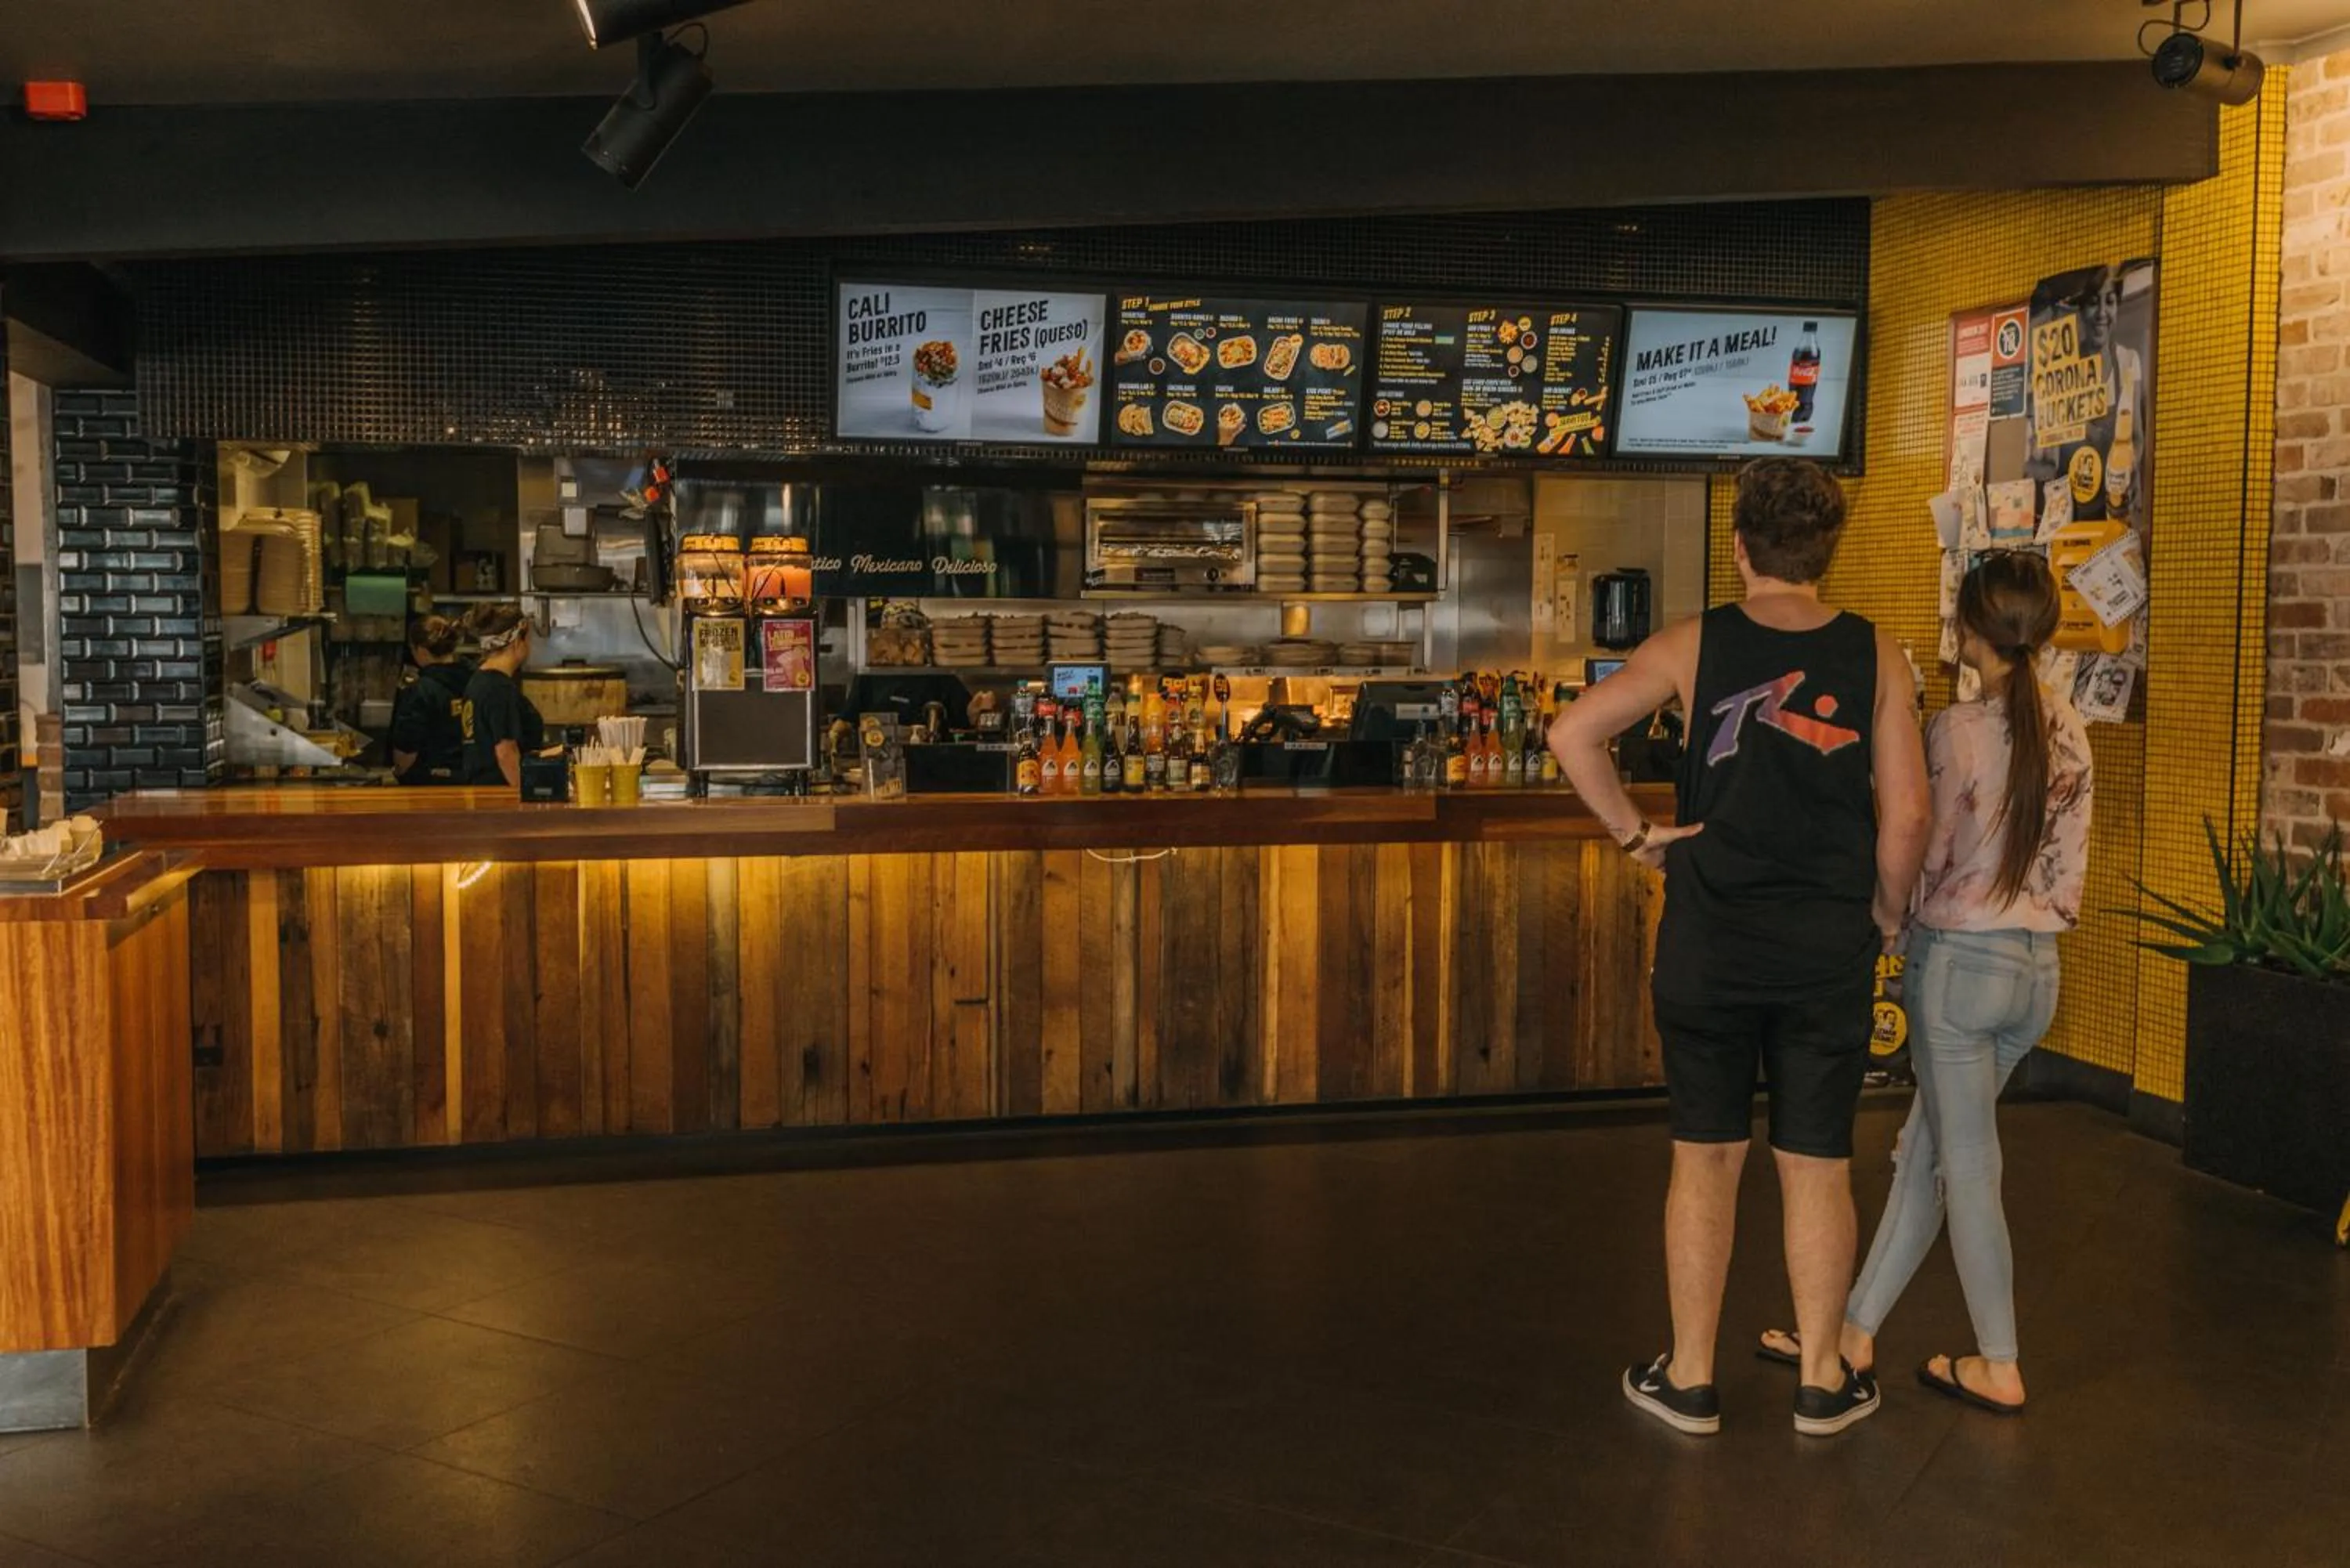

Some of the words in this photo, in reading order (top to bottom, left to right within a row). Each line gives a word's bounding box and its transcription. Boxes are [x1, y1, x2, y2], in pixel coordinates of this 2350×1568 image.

[848, 292, 891, 320] CALI
[980, 300, 1049, 331] CHEESE
[1122, 298, 1144, 311] STEP
[1383, 307, 1404, 320] STEP
[1469, 310, 1488, 323] STEP
[848, 310, 927, 345] BURRITO
[1550, 314, 1571, 326] STEP
[980, 327, 1030, 356] FRIES
[1035, 319, 1089, 348] (QUESO)
[1636, 343, 1686, 372] MAKE
[1688, 340, 1705, 362] IT
[1707, 337, 1719, 358] A
[1723, 326, 1777, 355] MEAL!
[2037, 322, 2075, 369] $20
[2037, 359, 2098, 399] CORONA
[851, 554, 923, 574] Mexicano
[931, 555, 998, 575] Delicioso
